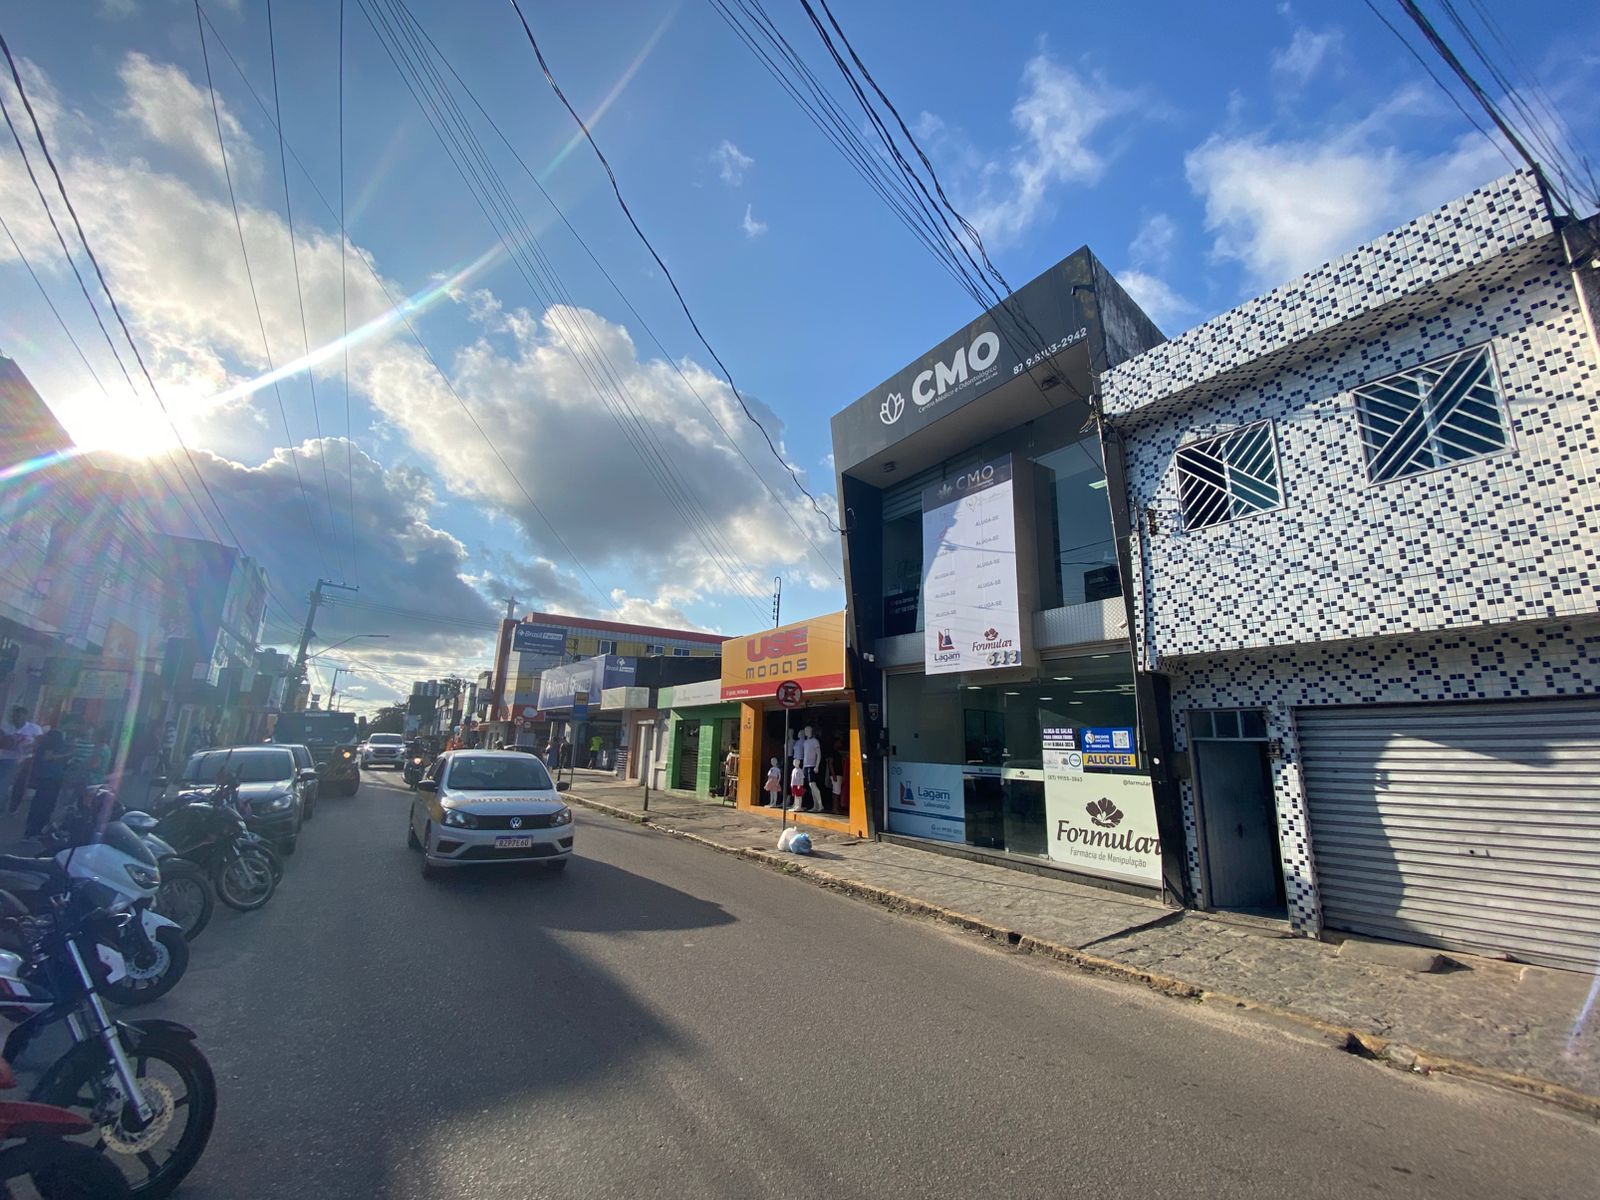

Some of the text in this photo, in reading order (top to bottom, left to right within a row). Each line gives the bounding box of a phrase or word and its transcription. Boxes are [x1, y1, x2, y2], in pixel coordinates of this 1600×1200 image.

[912, 331, 1000, 406] CMO
[1013, 363, 1024, 375] 87
[918, 402, 936, 413] Centro
[956, 465, 994, 490] CMO
[747, 625, 809, 662] USE
[972, 639, 1012, 652] Formular
[934, 652, 960, 662] Lagam
[746, 658, 808, 680] MODAS
[1087, 755, 1131, 765] ALUGUE!
[917, 786, 950, 800] Lagam
[1057, 820, 1161, 855] Formular
[1070, 847, 1147, 868] Farmácia de Manipulação
